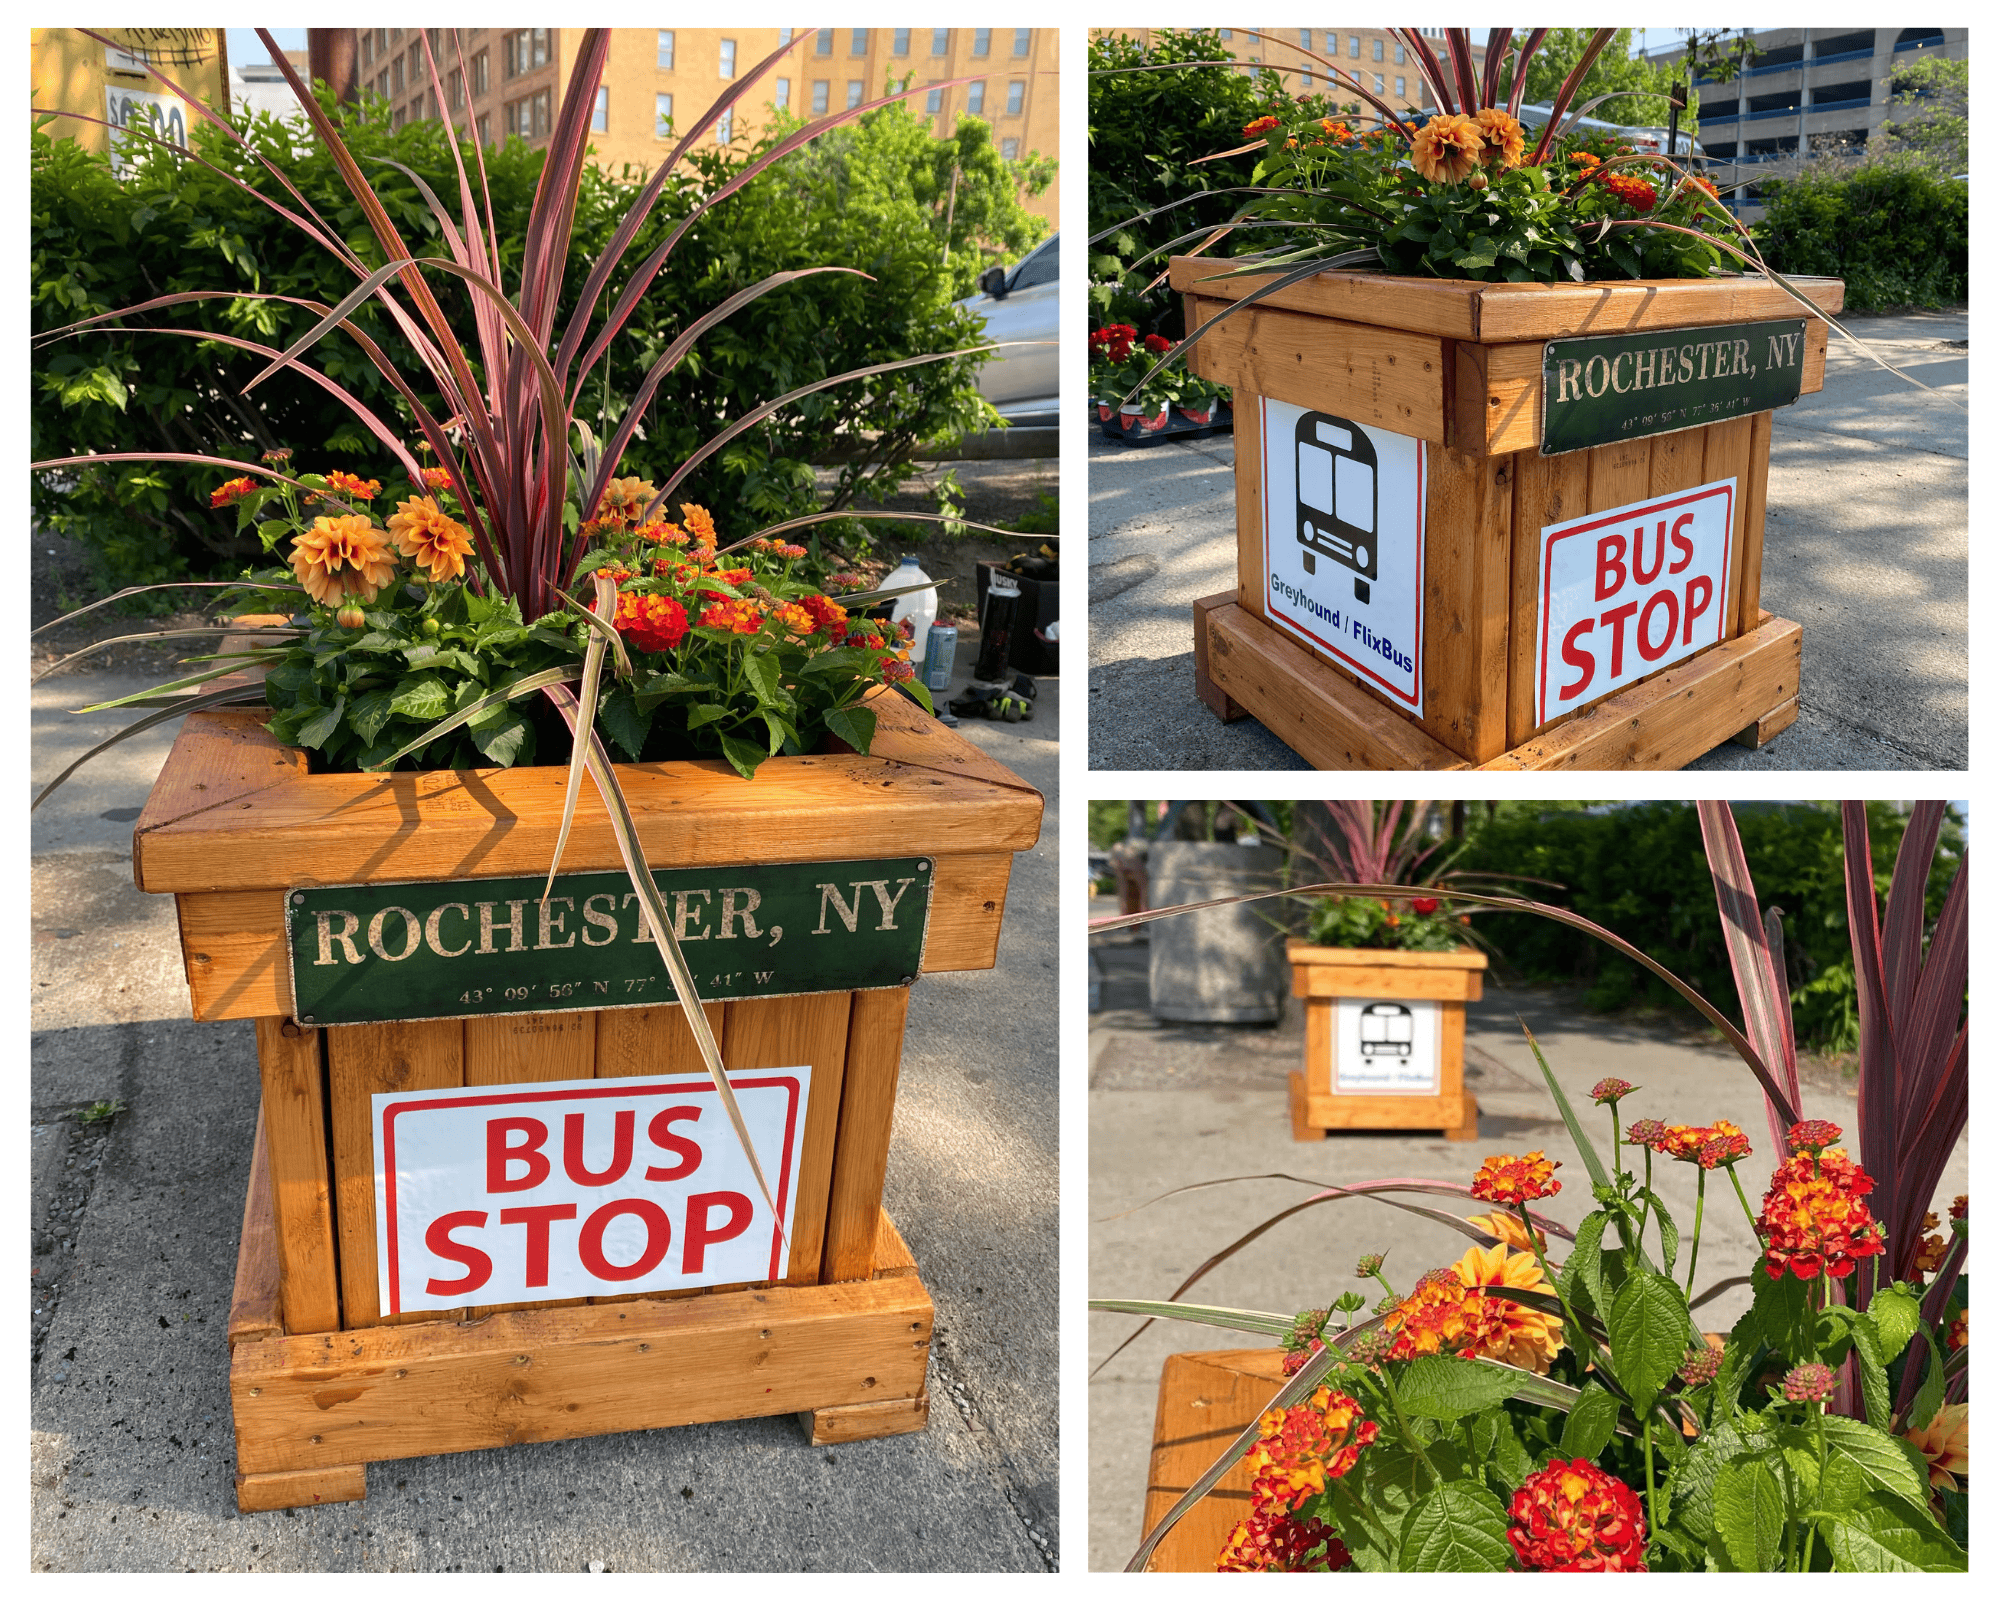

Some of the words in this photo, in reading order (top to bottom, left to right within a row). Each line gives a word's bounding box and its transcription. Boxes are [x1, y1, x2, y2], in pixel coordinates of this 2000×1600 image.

[1556, 338, 1756, 403] ROCHESTER,
[1765, 332, 1801, 371] NY
[1680, 408, 1687, 418] N
[1742, 396, 1751, 406] W
[1594, 512, 1695, 603] BUS
[1271, 573, 1340, 629] Greyhound
[1344, 616, 1349, 633] /
[1353, 620, 1413, 673] FlixBus
[1558, 574, 1713, 701] STOP
[311, 886, 783, 966] ROCHESTER,
[811, 878, 916, 935] NY
[593, 980, 609, 995] N
[753, 970, 774, 985] W
[486, 1105, 703, 1194] BUS
[424, 1190, 754, 1297] STOP
